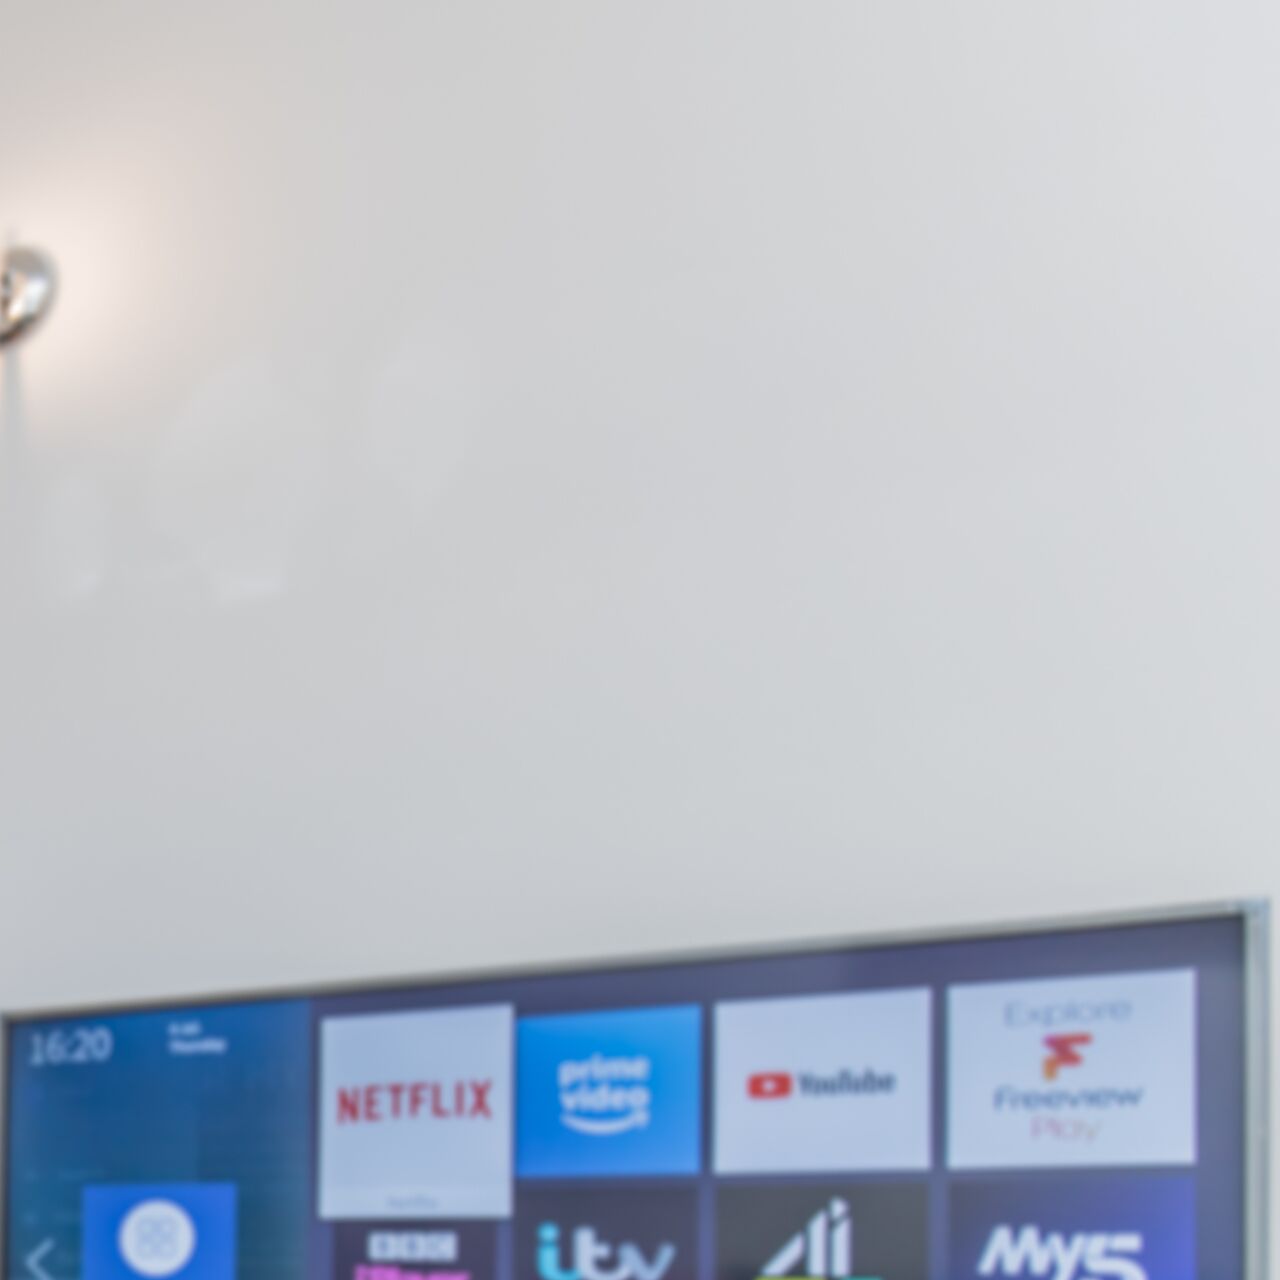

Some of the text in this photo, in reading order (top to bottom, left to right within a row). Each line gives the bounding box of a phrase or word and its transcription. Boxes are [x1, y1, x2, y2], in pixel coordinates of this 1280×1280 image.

[28, 1026, 114, 1067] 16:20
[557, 1053, 650, 1086] prime
[797, 1067, 896, 1096] YouTube
[336, 1077, 493, 1126] NETFLIX
[559, 1082, 650, 1113] video
